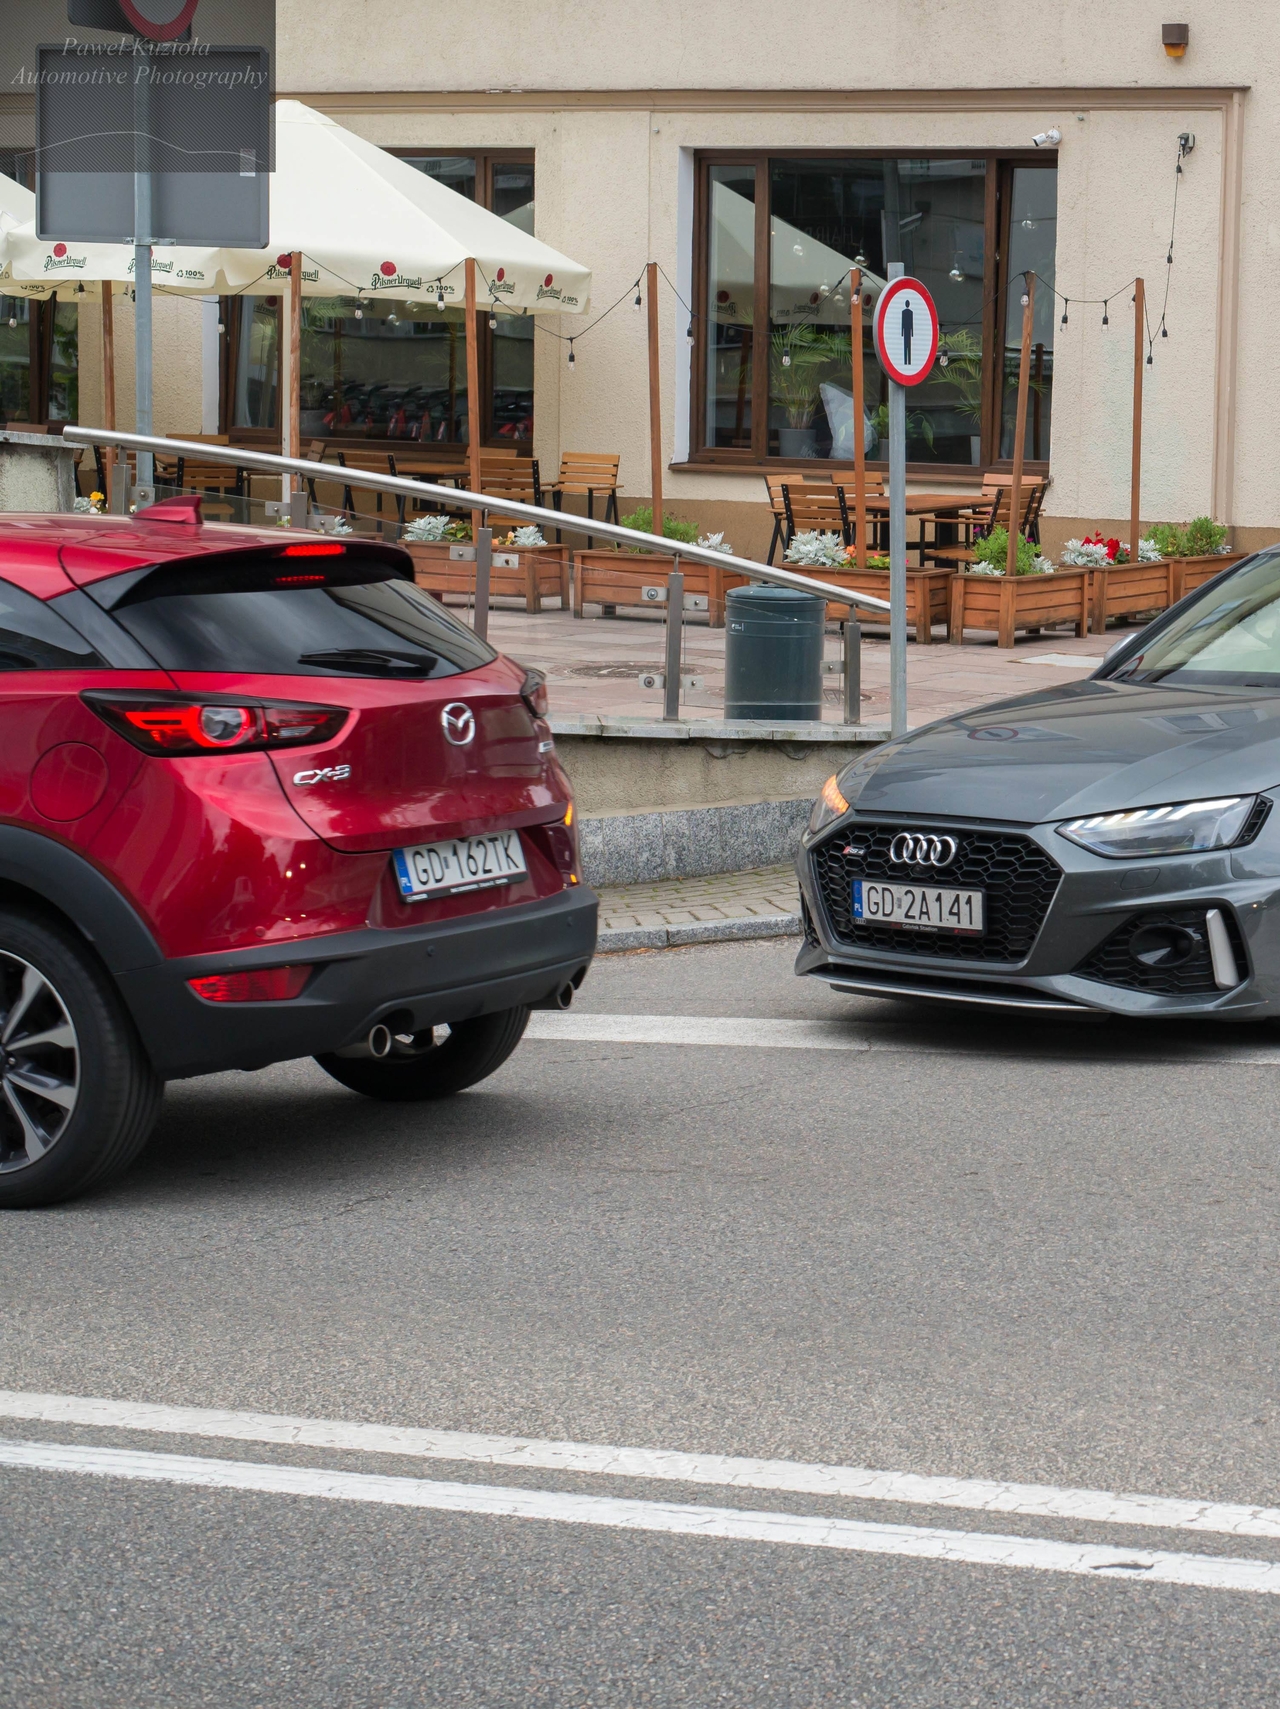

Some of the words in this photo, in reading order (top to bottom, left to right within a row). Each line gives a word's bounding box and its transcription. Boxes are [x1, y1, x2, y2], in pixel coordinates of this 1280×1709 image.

[371, 273, 396, 290] Pilsner
[397, 274, 422, 289] Urquell
[293, 764, 351, 786] CX-3
[413, 848, 444, 886] GD
[452, 834, 519, 878] 162TK
[854, 903, 862, 912] PL
[868, 885, 894, 917] GD
[904, 889, 973, 925] 2A141
